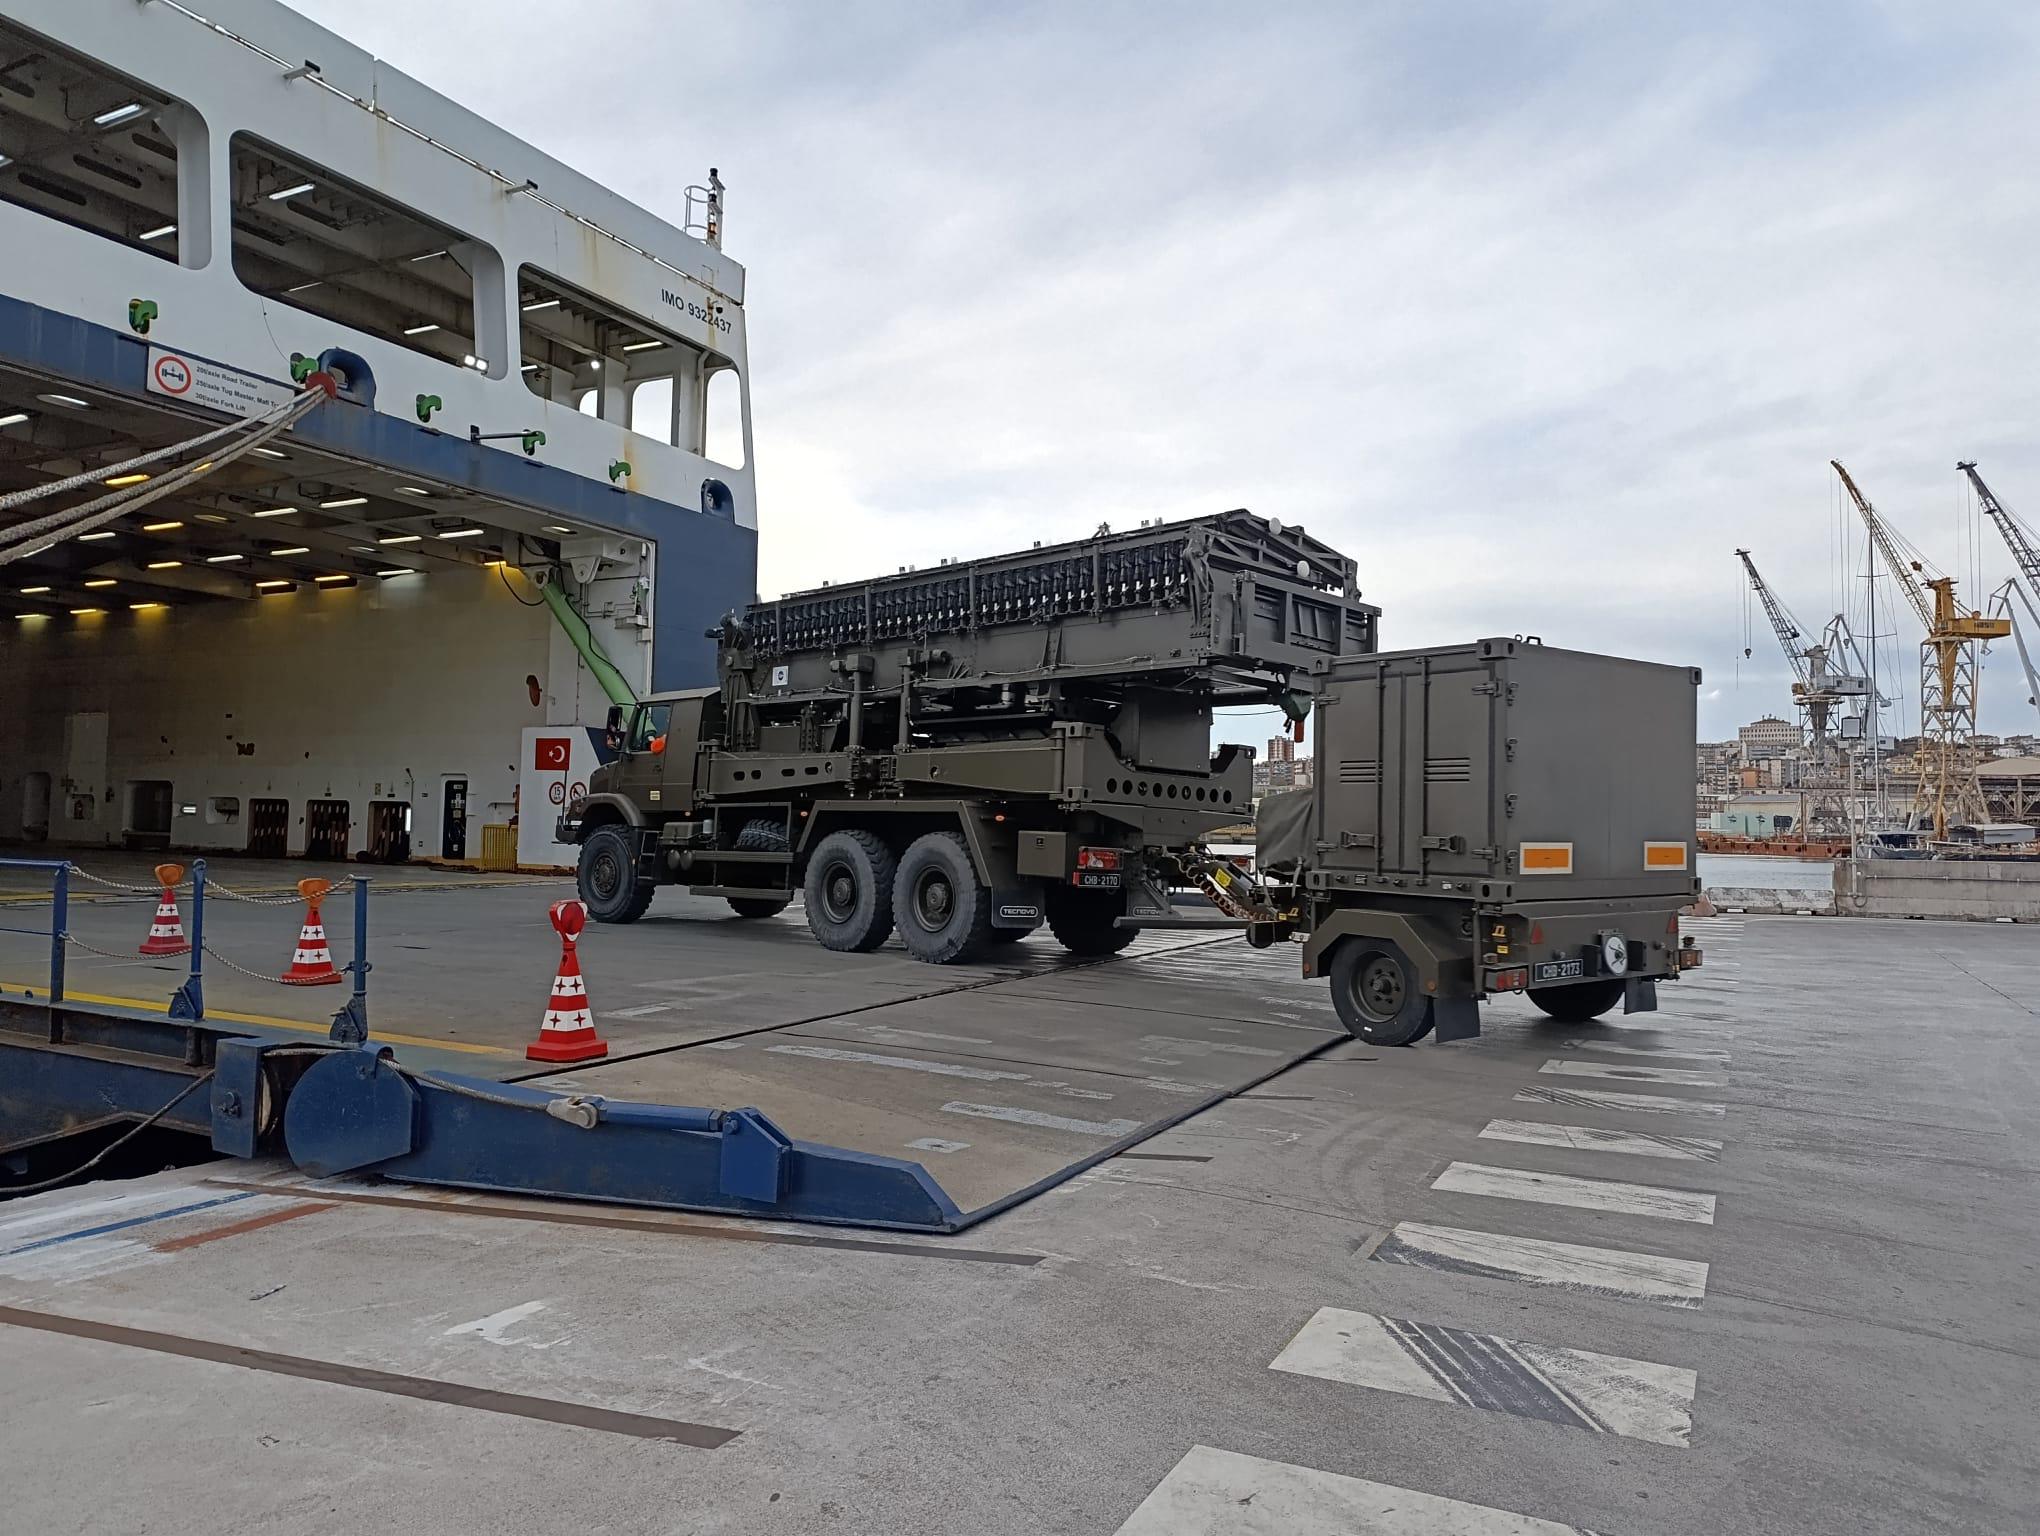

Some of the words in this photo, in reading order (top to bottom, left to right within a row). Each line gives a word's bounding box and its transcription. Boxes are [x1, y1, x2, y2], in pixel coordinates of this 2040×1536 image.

[662, 288, 684, 310] IMO
[688, 302, 732, 335] 9322437
[221, 373, 238, 384] Road
[239, 379, 258, 390] Trailer
[221, 386, 233, 397] Tug
[221, 399, 234, 408] Fork
[236, 404, 246, 412] Lift
[554, 786, 560, 795] 15
[1084, 875, 1118, 885] CHB-2170
